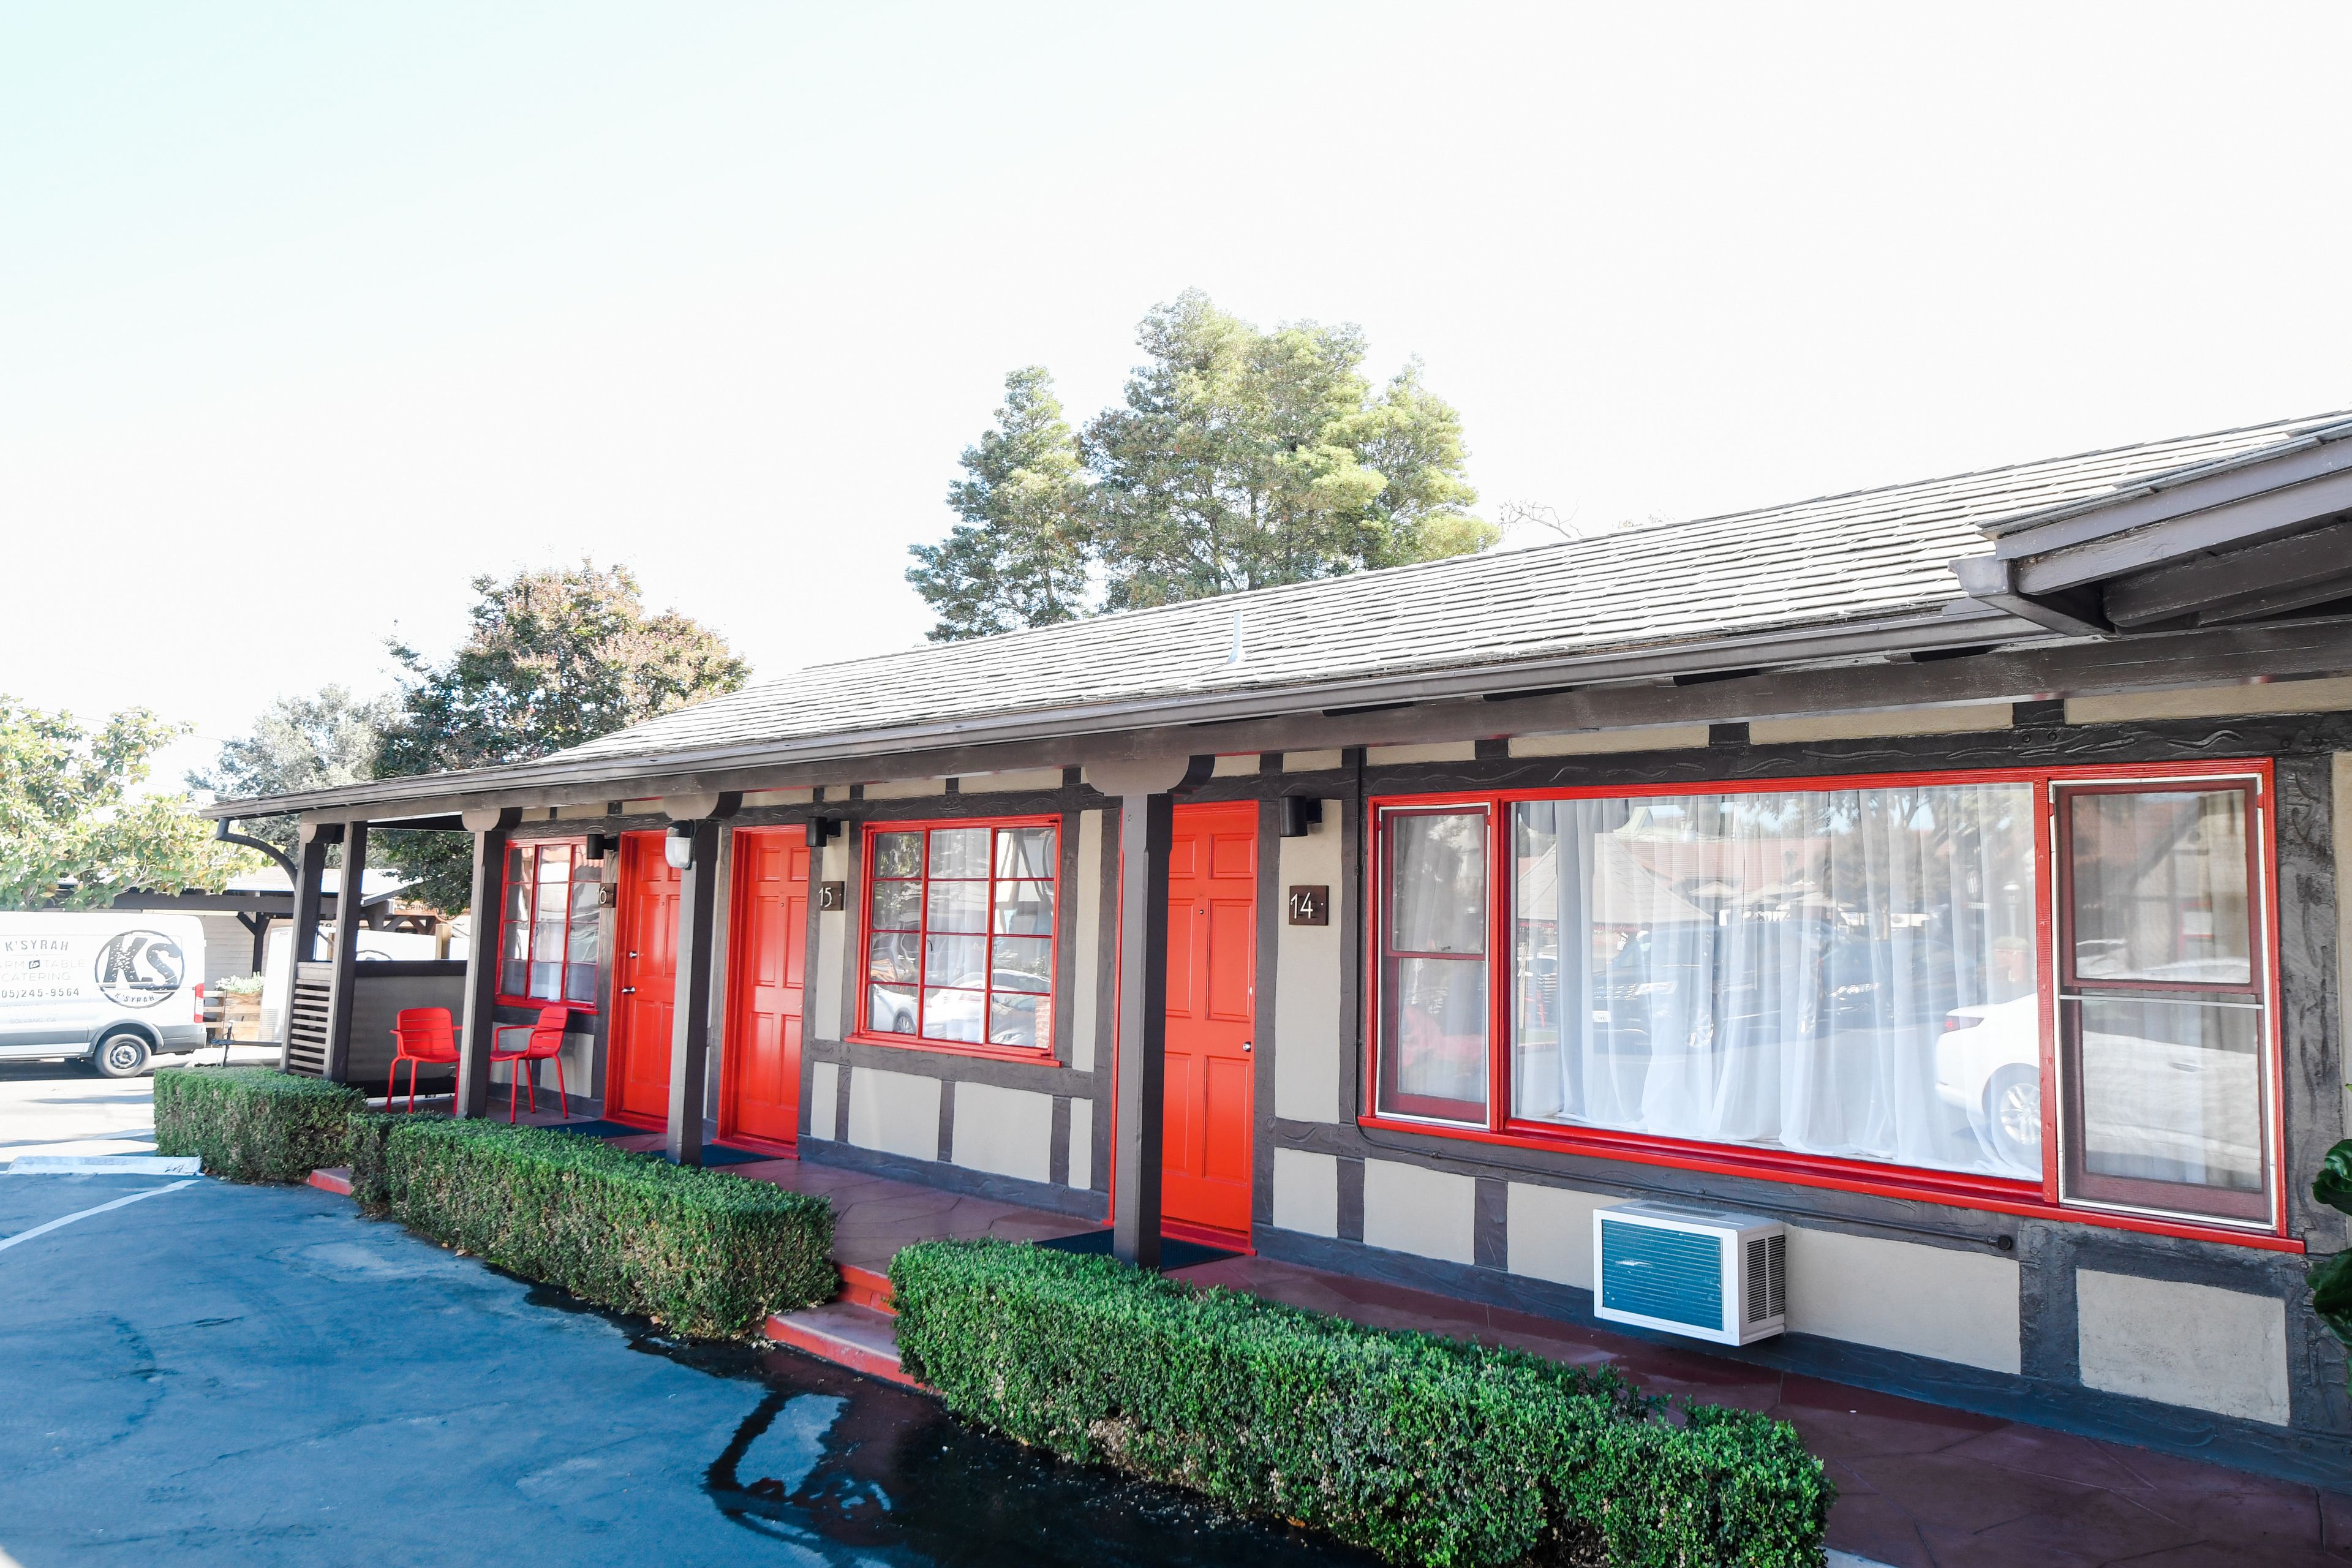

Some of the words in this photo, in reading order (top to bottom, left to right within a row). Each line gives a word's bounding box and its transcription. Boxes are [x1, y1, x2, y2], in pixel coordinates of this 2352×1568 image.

[818, 887, 832, 908] 15
[1290, 892, 1314, 919] 14
[5, 940, 69, 952] K'SYRAH
[0, 960, 25, 969] RM
[44, 959, 86, 968] TABLE
[1, 972, 70, 982] CATERING
